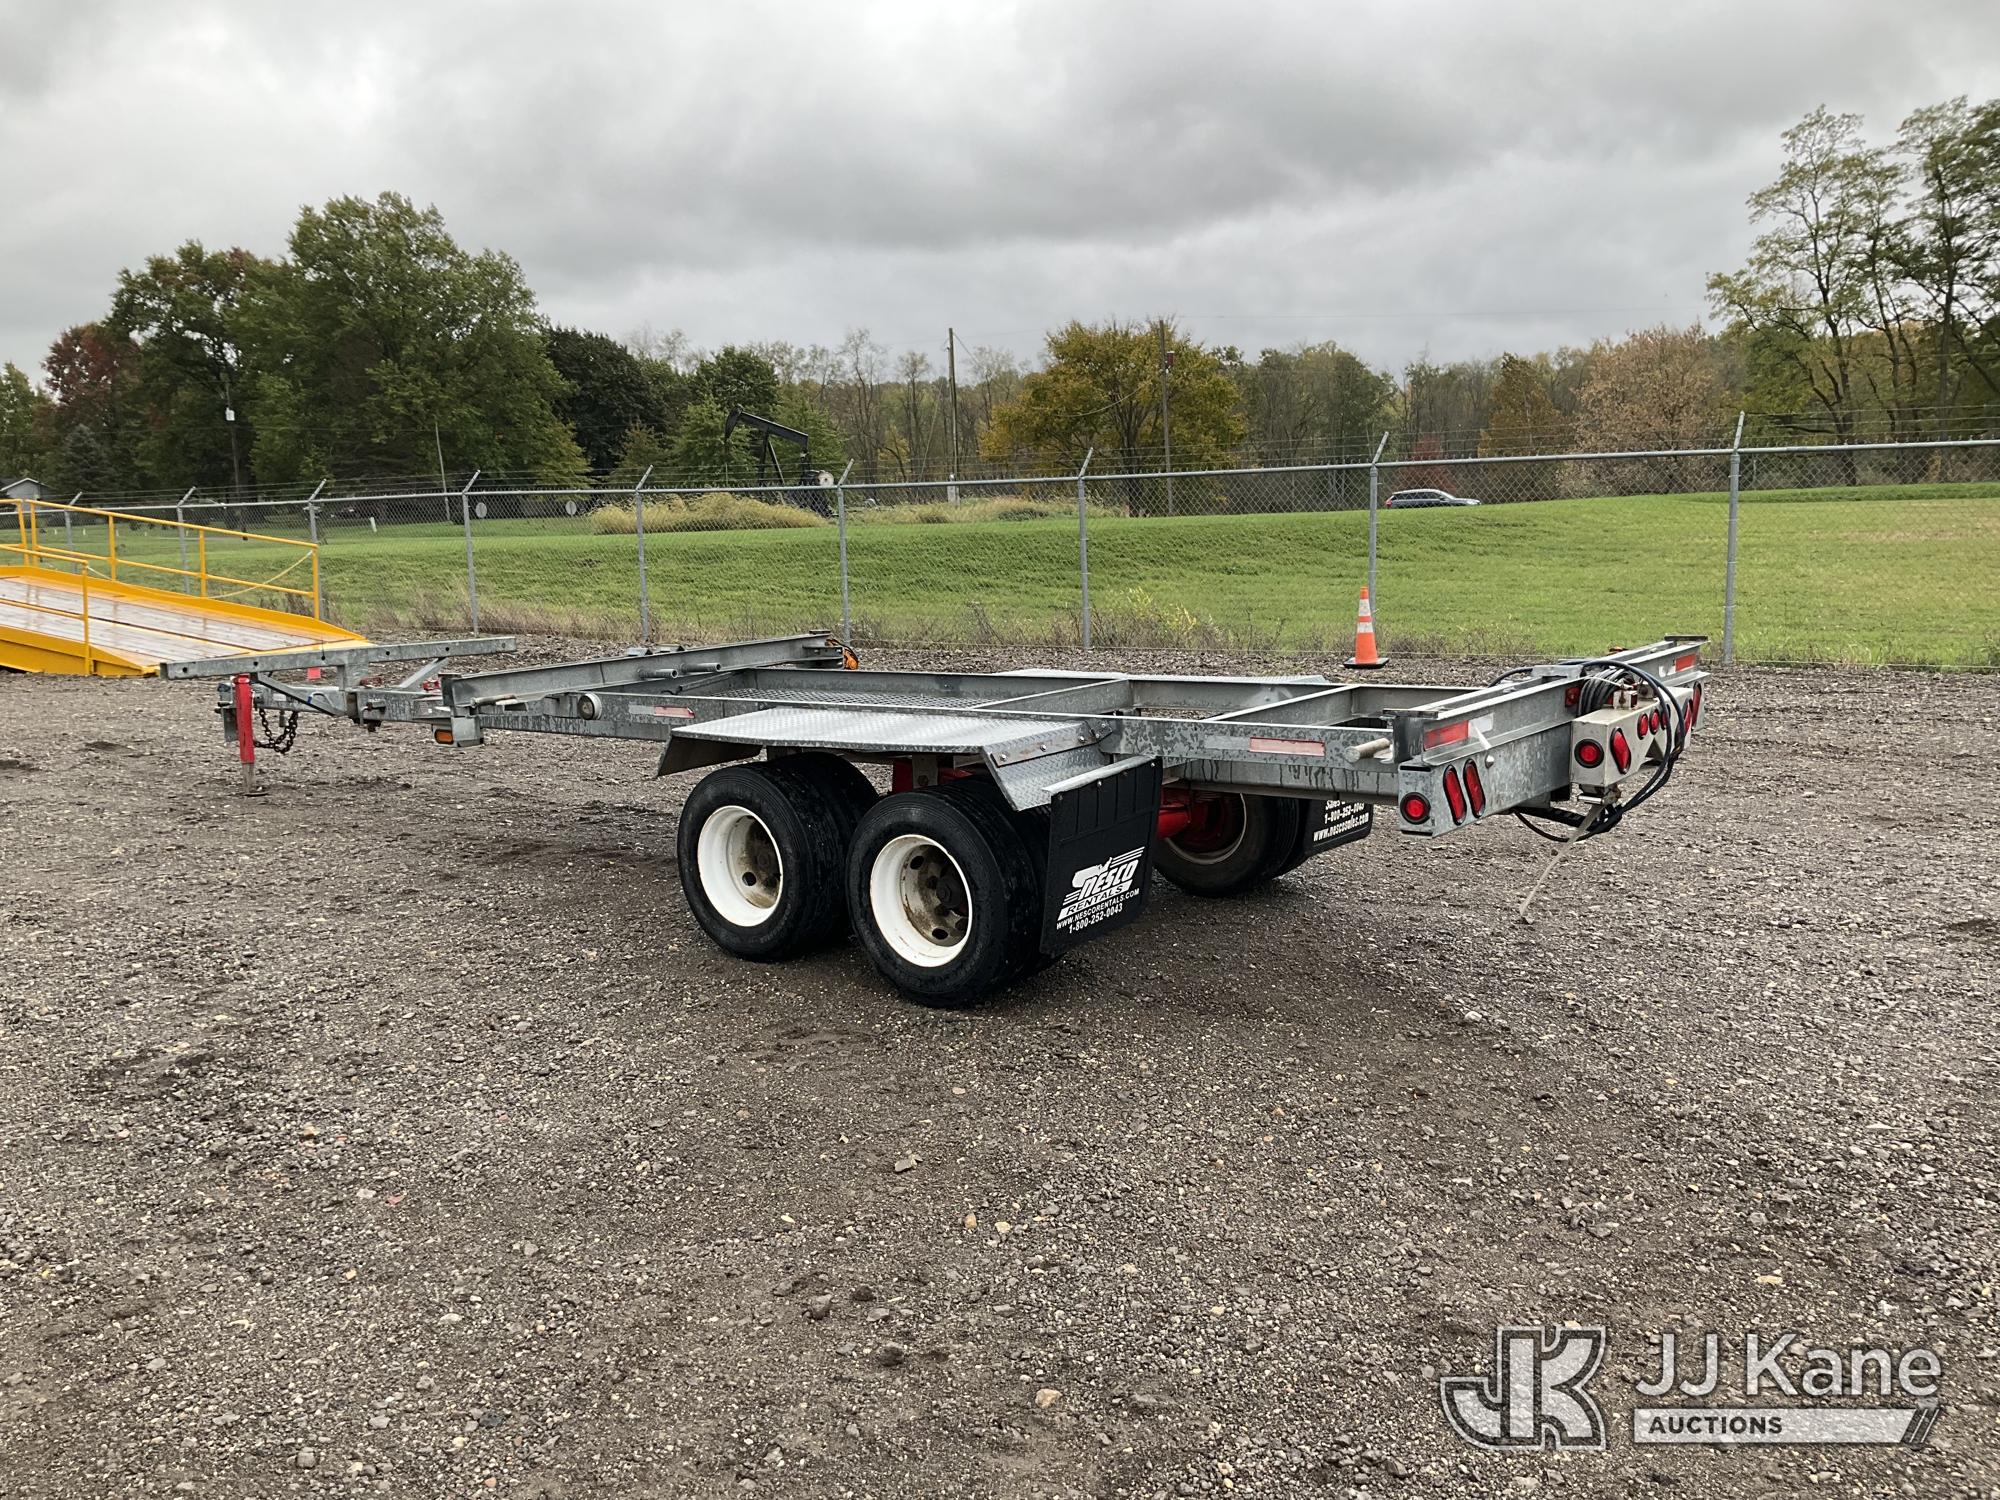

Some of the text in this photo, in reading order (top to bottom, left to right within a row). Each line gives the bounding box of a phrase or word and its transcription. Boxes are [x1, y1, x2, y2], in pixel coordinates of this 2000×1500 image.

[1056, 888, 1140, 930] WWW.NESCORENTALS.COM
[1066, 884, 1124, 916] RENTALS
[1069, 903, 1123, 934] 1-800-252-0043
